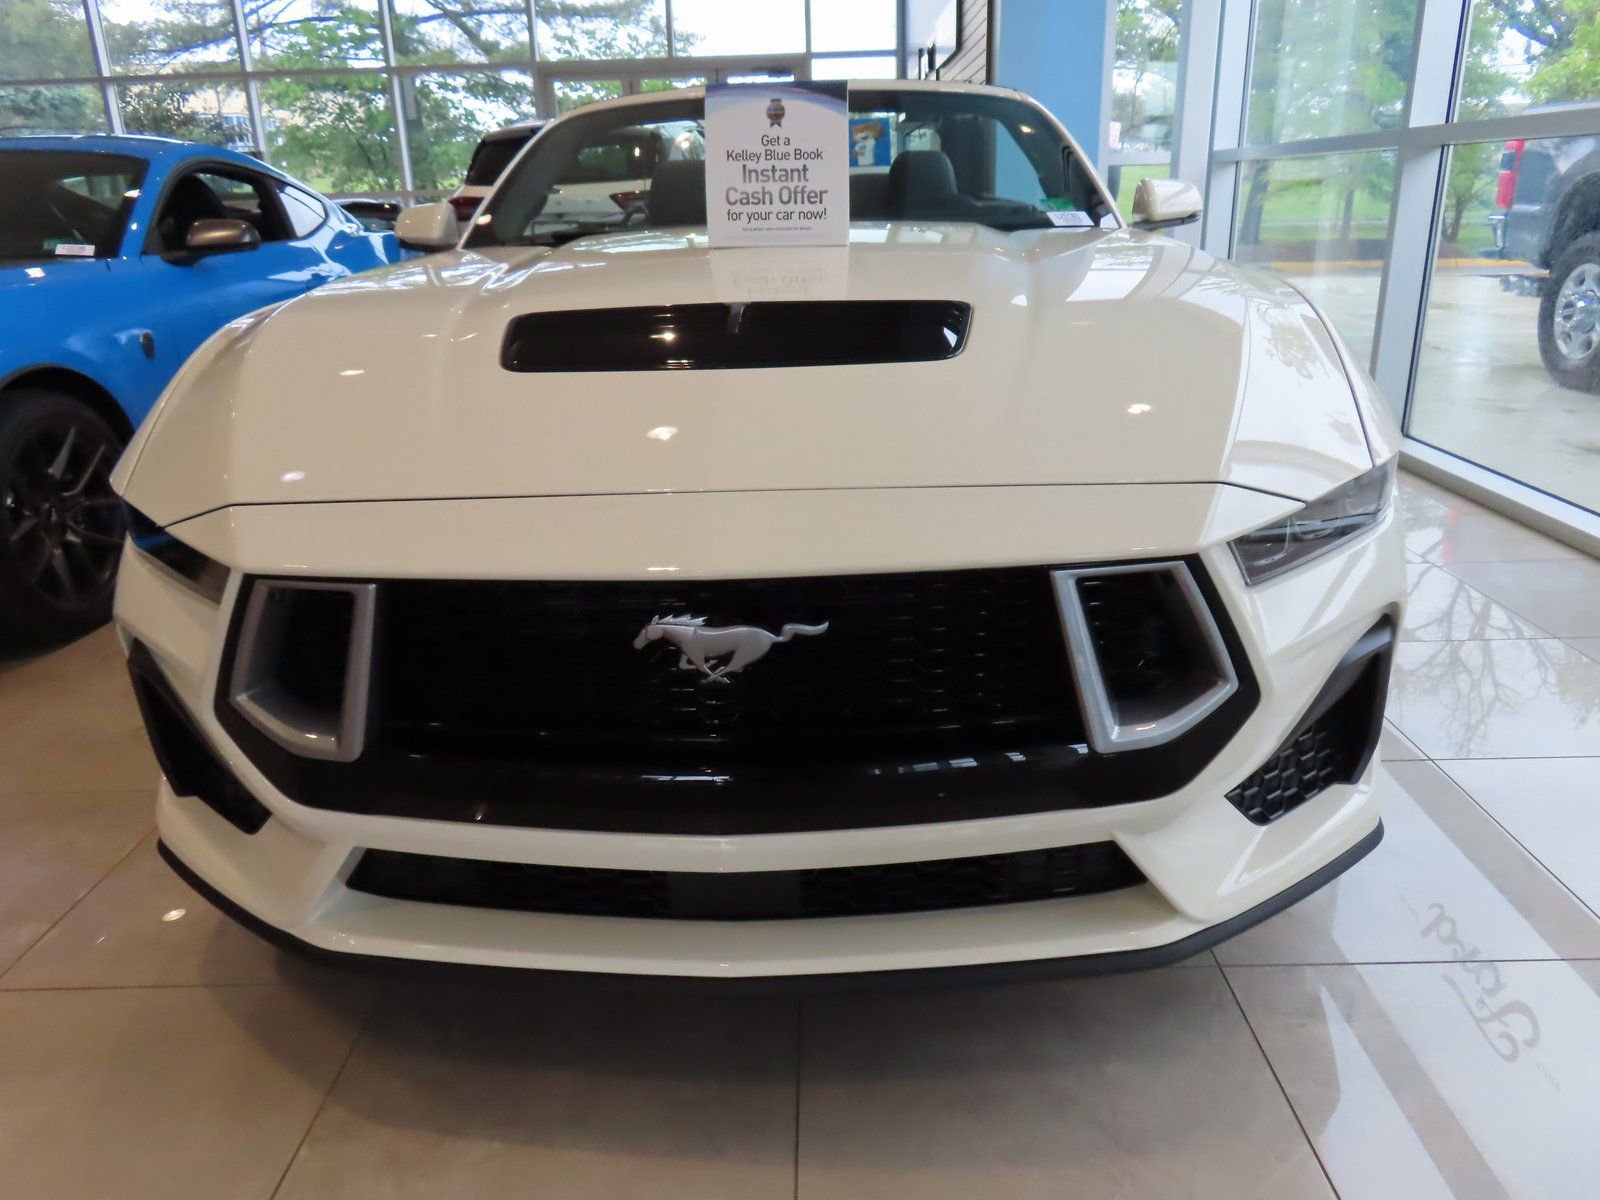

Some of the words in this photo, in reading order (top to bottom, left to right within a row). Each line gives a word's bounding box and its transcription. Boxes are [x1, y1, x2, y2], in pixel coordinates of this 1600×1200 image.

[761, 134, 781, 147] Get
[783, 136, 791, 147] a
[726, 149, 762, 164] Kelley
[764, 149, 791, 161] Blue
[794, 148, 823, 161] Book
[742, 164, 809, 184] Instant
[725, 186, 773, 206] Cash
[778, 185, 828, 205] Offer
[727, 208, 744, 221] for
[747, 210, 773, 224] your
[776, 210, 795, 221] car
[798, 207, 827, 221] now!
[1419, 901, 1541, 1063] Ford
